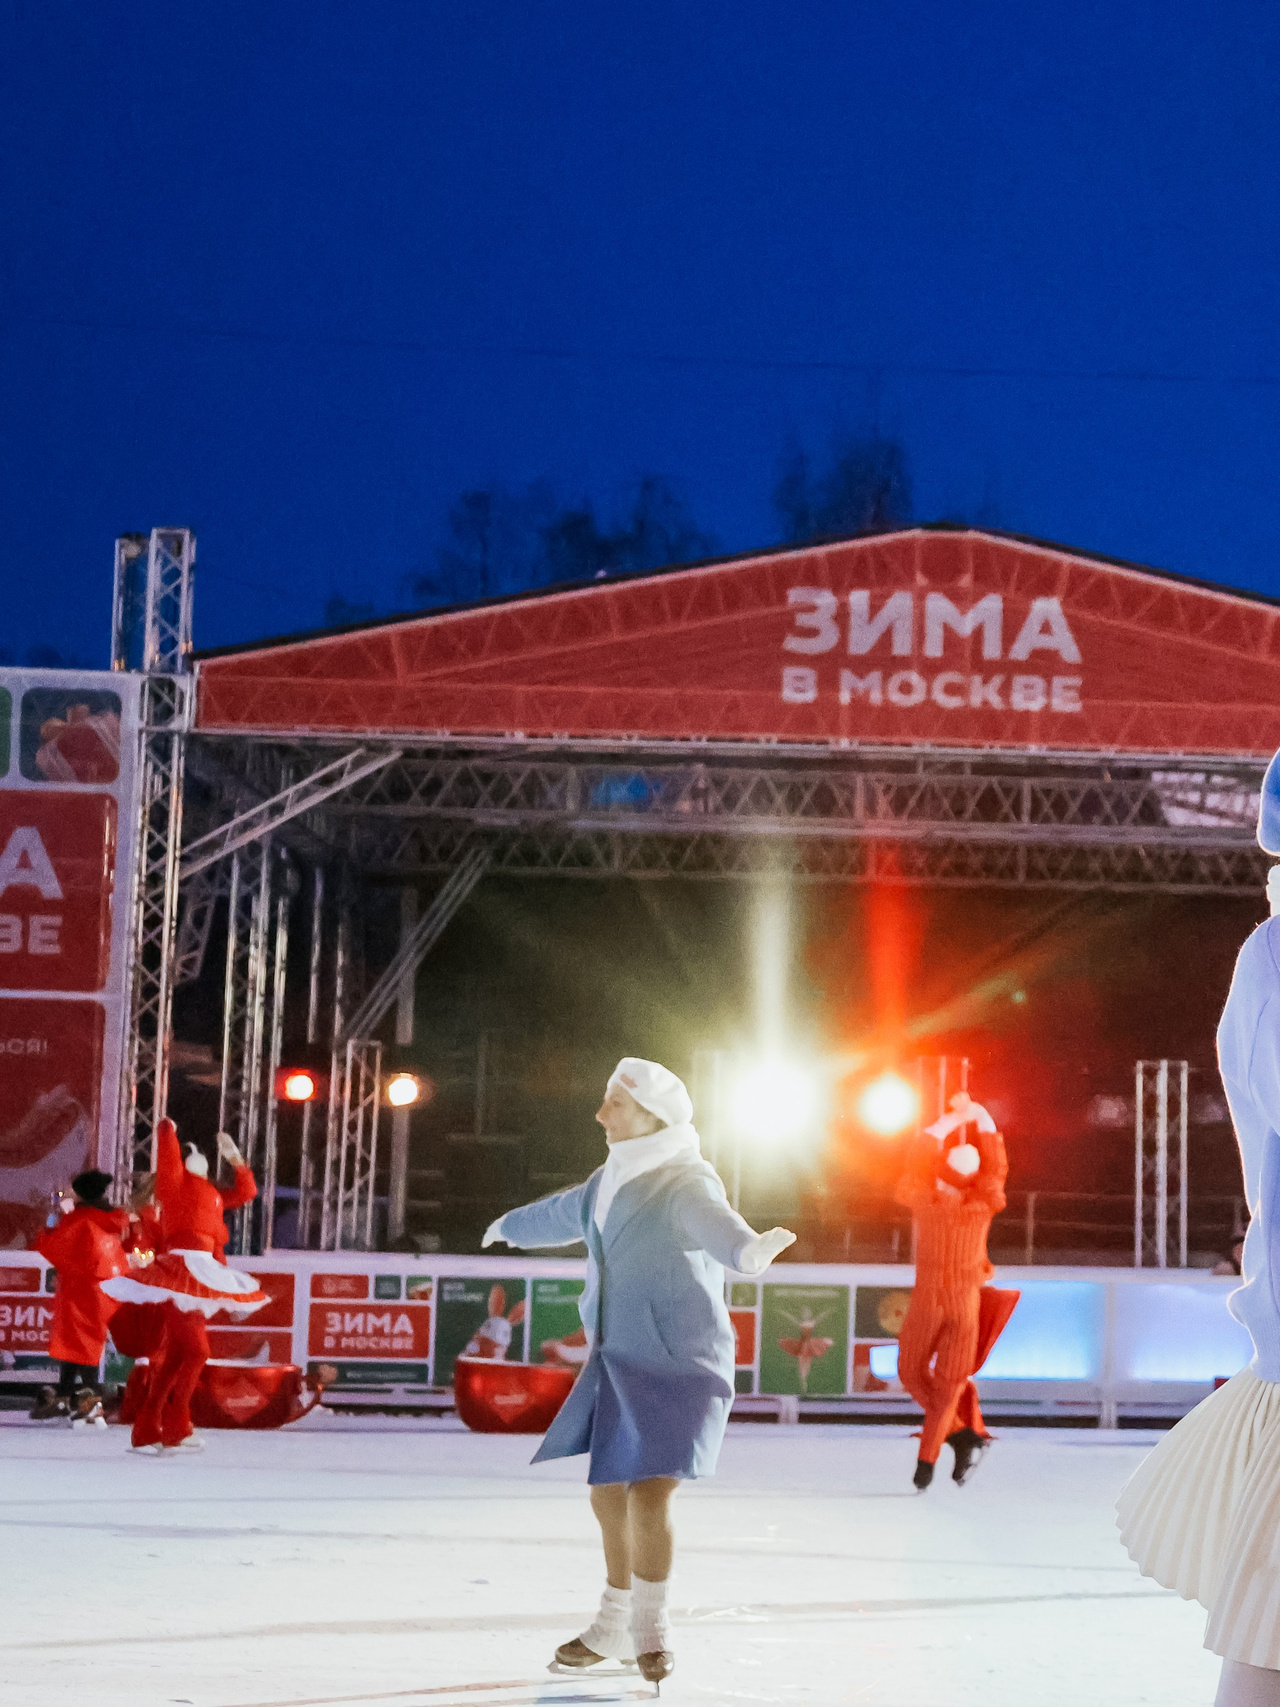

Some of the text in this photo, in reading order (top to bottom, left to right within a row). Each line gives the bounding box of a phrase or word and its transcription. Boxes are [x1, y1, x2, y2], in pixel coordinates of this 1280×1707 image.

[782, 586, 1082, 664] ЗИМА
[781, 666, 1083, 713] В МОСКВЕ
[324, 1312, 414, 1334] ЗИМА
